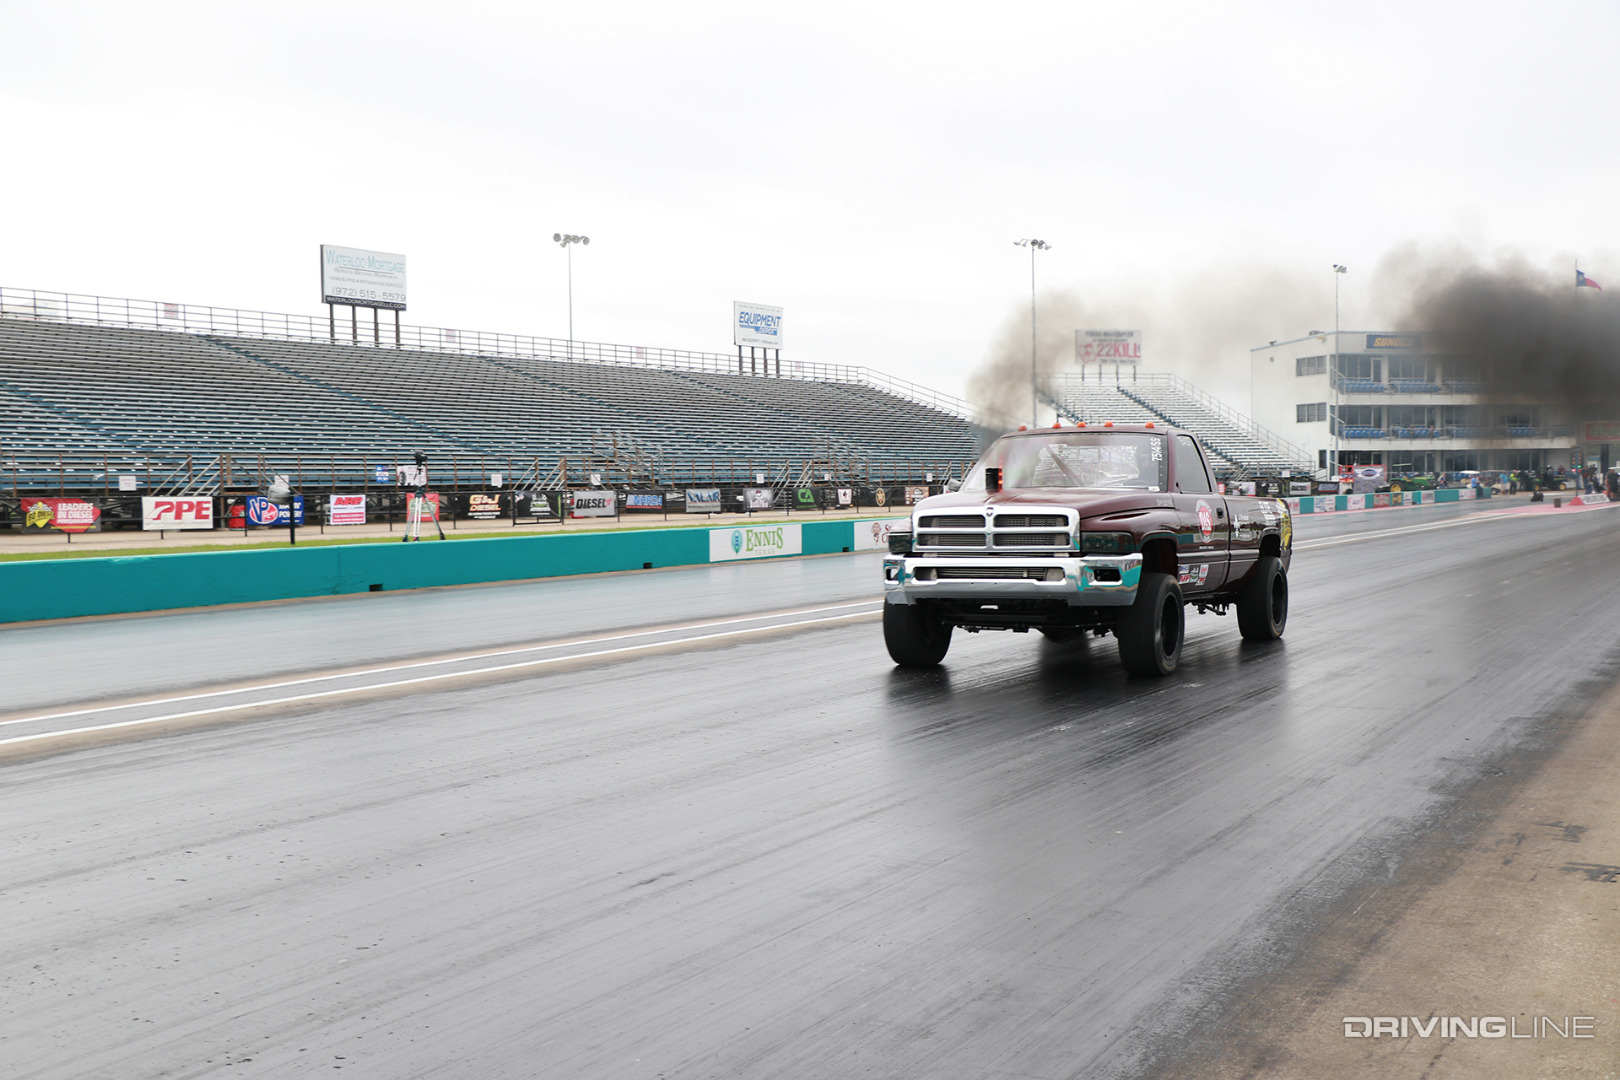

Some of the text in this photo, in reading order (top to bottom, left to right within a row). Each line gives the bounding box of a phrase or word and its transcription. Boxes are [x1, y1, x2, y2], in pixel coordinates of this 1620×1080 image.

[326, 249, 405, 273] WATERLOO MORTGAGE
[332, 287, 357, 297] (972)
[739, 311, 781, 328] EQUIPMENT
[1097, 342, 1140, 359] 22KILL
[334, 497, 363, 505] ARP
[469, 494, 501, 504] G&J
[576, 498, 606, 509] DIESEL
[57, 503, 94, 511] LEADERS
[150, 501, 211, 520] PPE
[250, 497, 269, 522] VP
